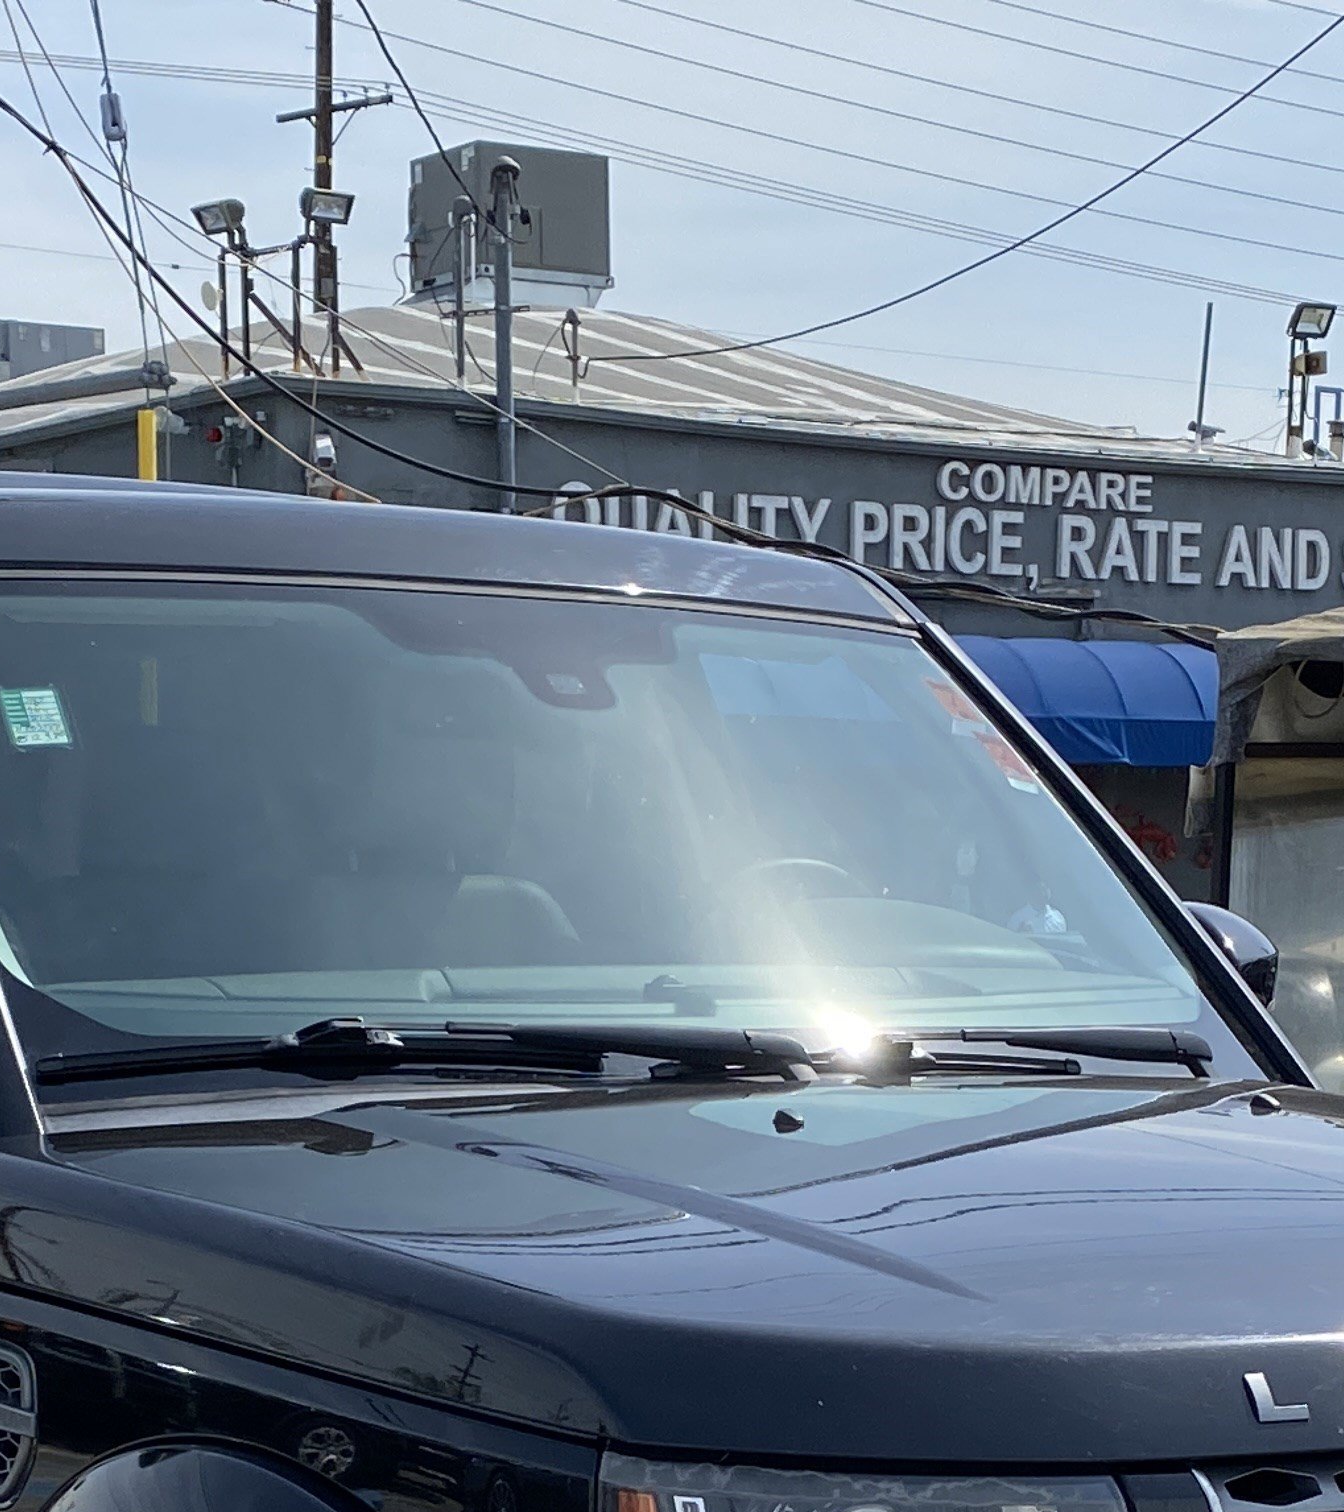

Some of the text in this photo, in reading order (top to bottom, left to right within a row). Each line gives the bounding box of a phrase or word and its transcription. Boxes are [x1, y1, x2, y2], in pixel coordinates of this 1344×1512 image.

[937, 460, 1153, 512] COMPARE
[850, 501, 1038, 591] PRICE,
[1057, 513, 1202, 585] RATE
[1215, 524, 1331, 591] AND
